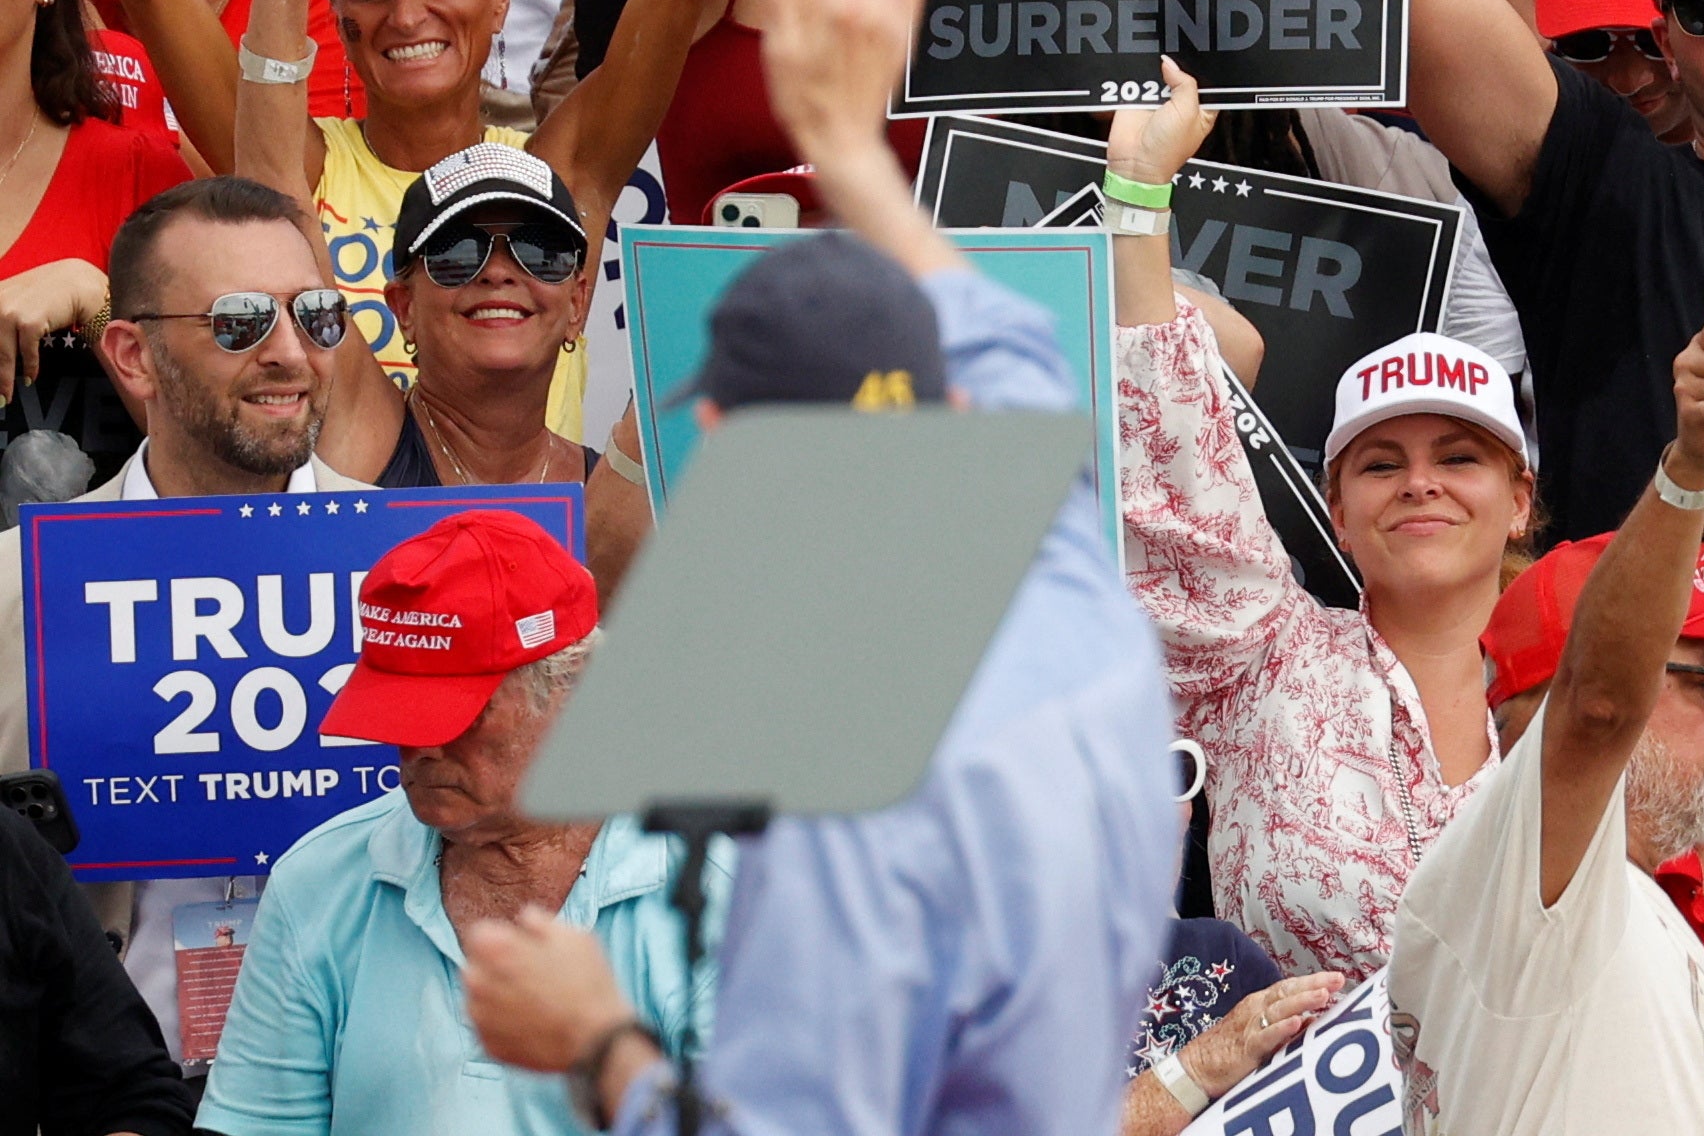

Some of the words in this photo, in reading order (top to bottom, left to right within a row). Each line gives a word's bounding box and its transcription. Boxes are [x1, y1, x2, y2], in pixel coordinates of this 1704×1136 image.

[1356, 350, 1490, 402] TRUMP
[84, 571, 362, 663] TRU
[391, 609, 463, 629] AMERICA
[393, 632, 453, 651] AGAIN
[83, 774, 184, 806] TEXT
[198, 769, 341, 801] TRUMP
[352, 765, 402, 795] TO
